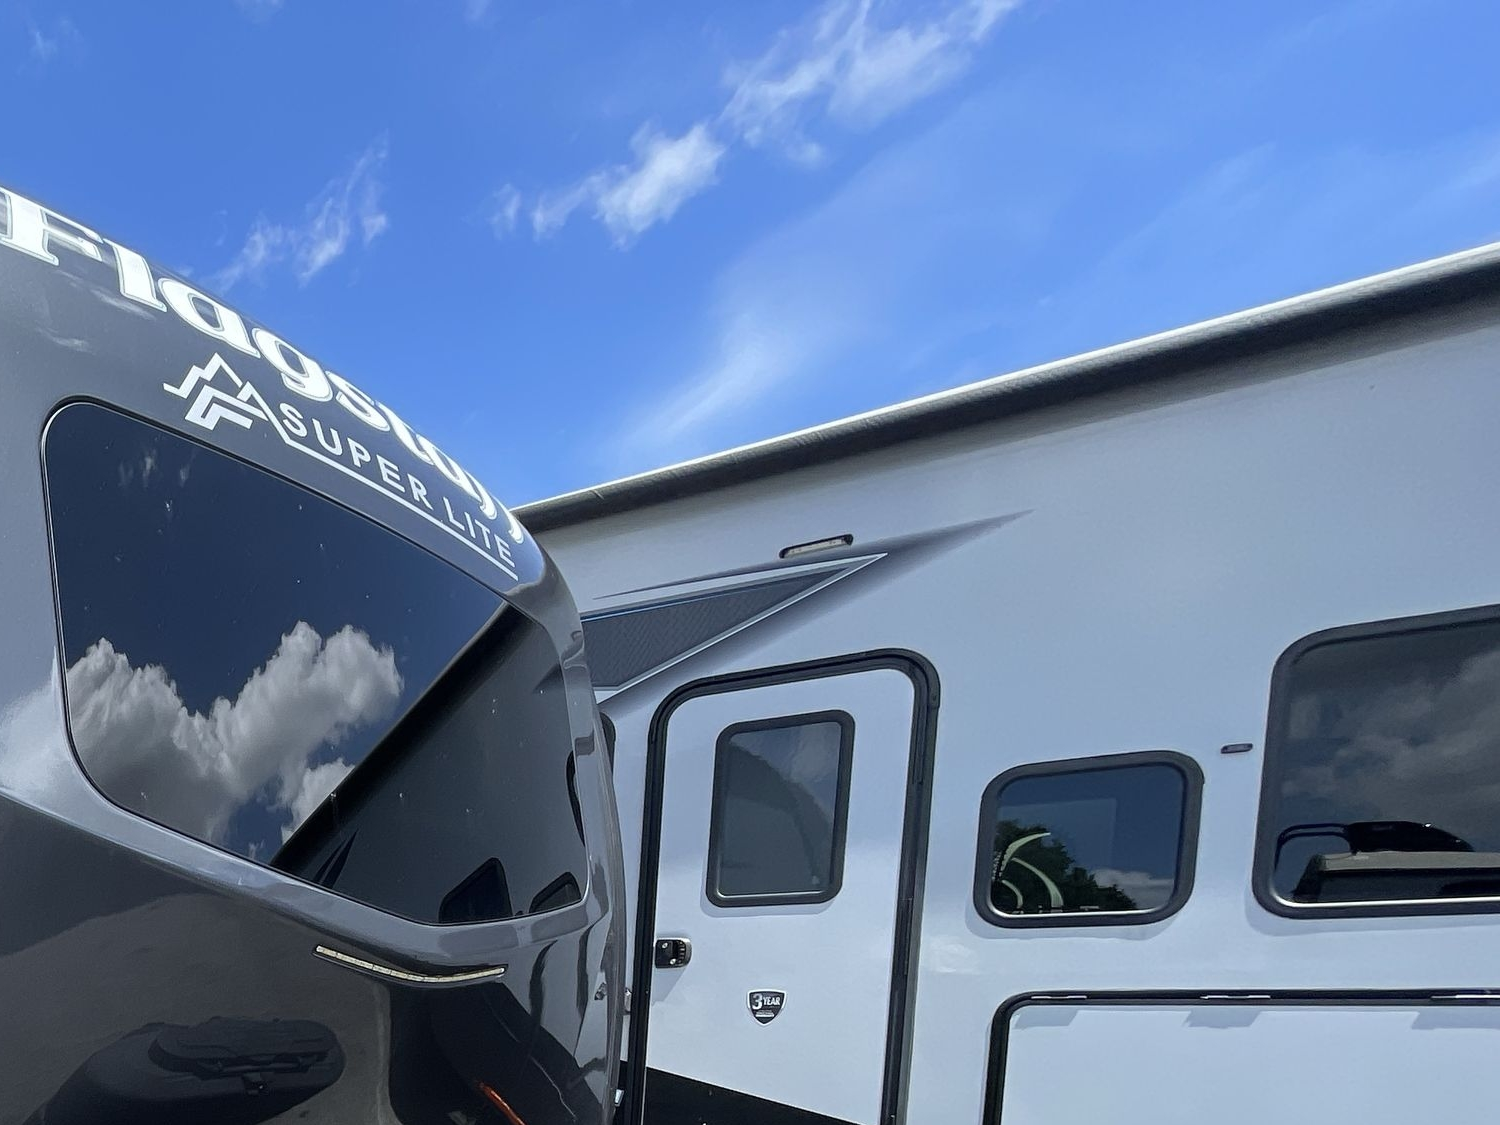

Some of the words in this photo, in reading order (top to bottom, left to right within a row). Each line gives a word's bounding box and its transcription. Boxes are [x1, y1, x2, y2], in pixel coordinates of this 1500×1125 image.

[280, 402, 434, 511] SUPER
[443, 496, 516, 568] LITE
[752, 993, 763, 1010] 3
[762, 996, 781, 1006] YEAR
